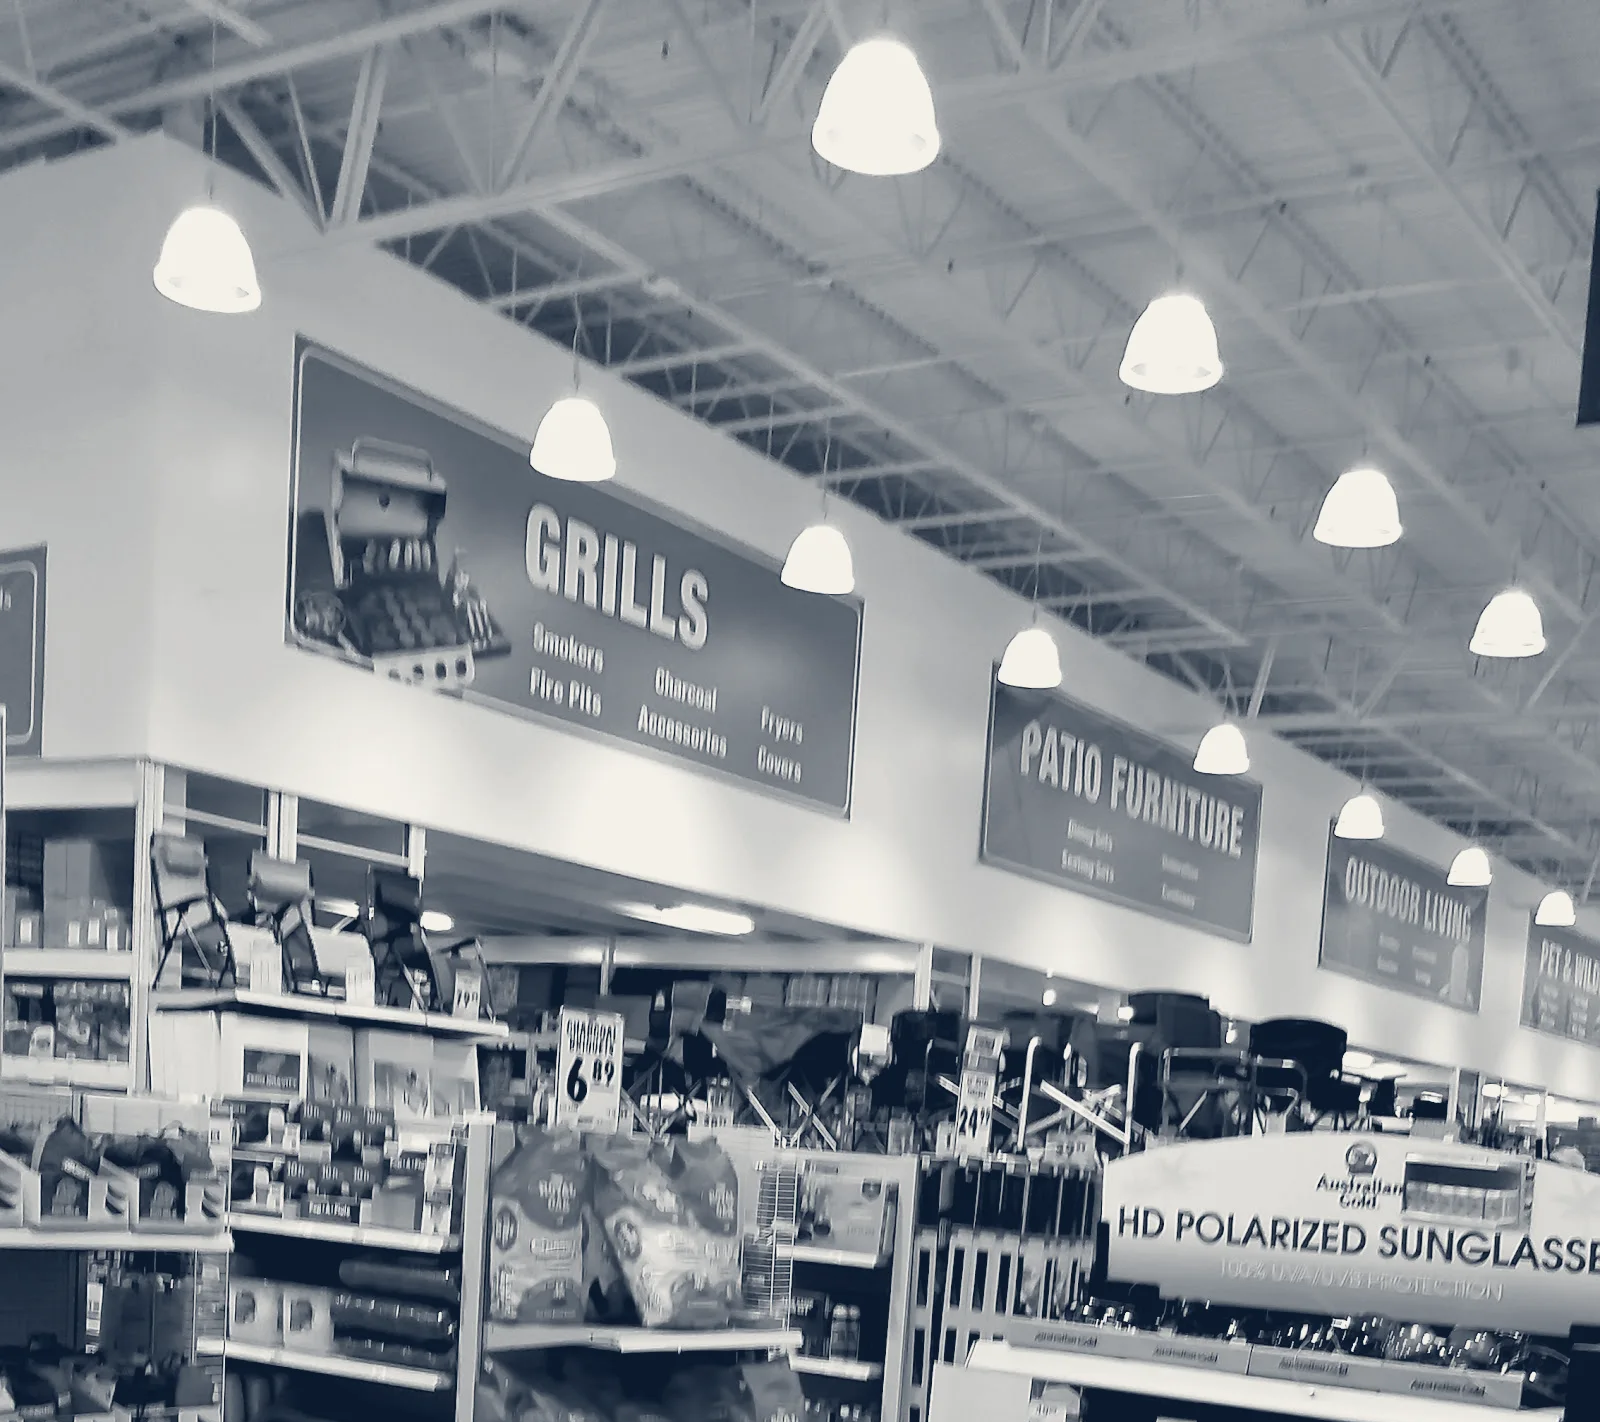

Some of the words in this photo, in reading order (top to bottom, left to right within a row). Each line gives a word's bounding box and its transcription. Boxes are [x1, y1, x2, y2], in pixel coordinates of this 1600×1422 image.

[525, 501, 708, 651] GRILLS
[533, 621, 604, 674] Smokers
[530, 666, 565, 704] Fire
[568, 679, 602, 717] Pits
[655, 665, 718, 714] Charcoal
[637, 703, 727, 760] Accessories
[760, 704, 803, 745] Fryers
[756, 744, 801, 784] Covers
[1020, 719, 1101, 804] PATIO
[1110, 754, 1244, 860] FURNITURE
[1345, 855, 1421, 925] OUTDOOR
[1423, 889, 1471, 942] LIVING
[1540, 938, 1562, 979] PET
[1562, 949, 1572, 983] &
[1316, 1172, 1403, 1196] Australian
[1339, 1193, 1379, 1209] Gold
[1118, 1204, 1165, 1239] HD
[1176, 1208, 1367, 1255] POLARIZED
[1220, 1257, 1267, 1278] 100%
[1366, 1271, 1505, 1301] PROTECTION
